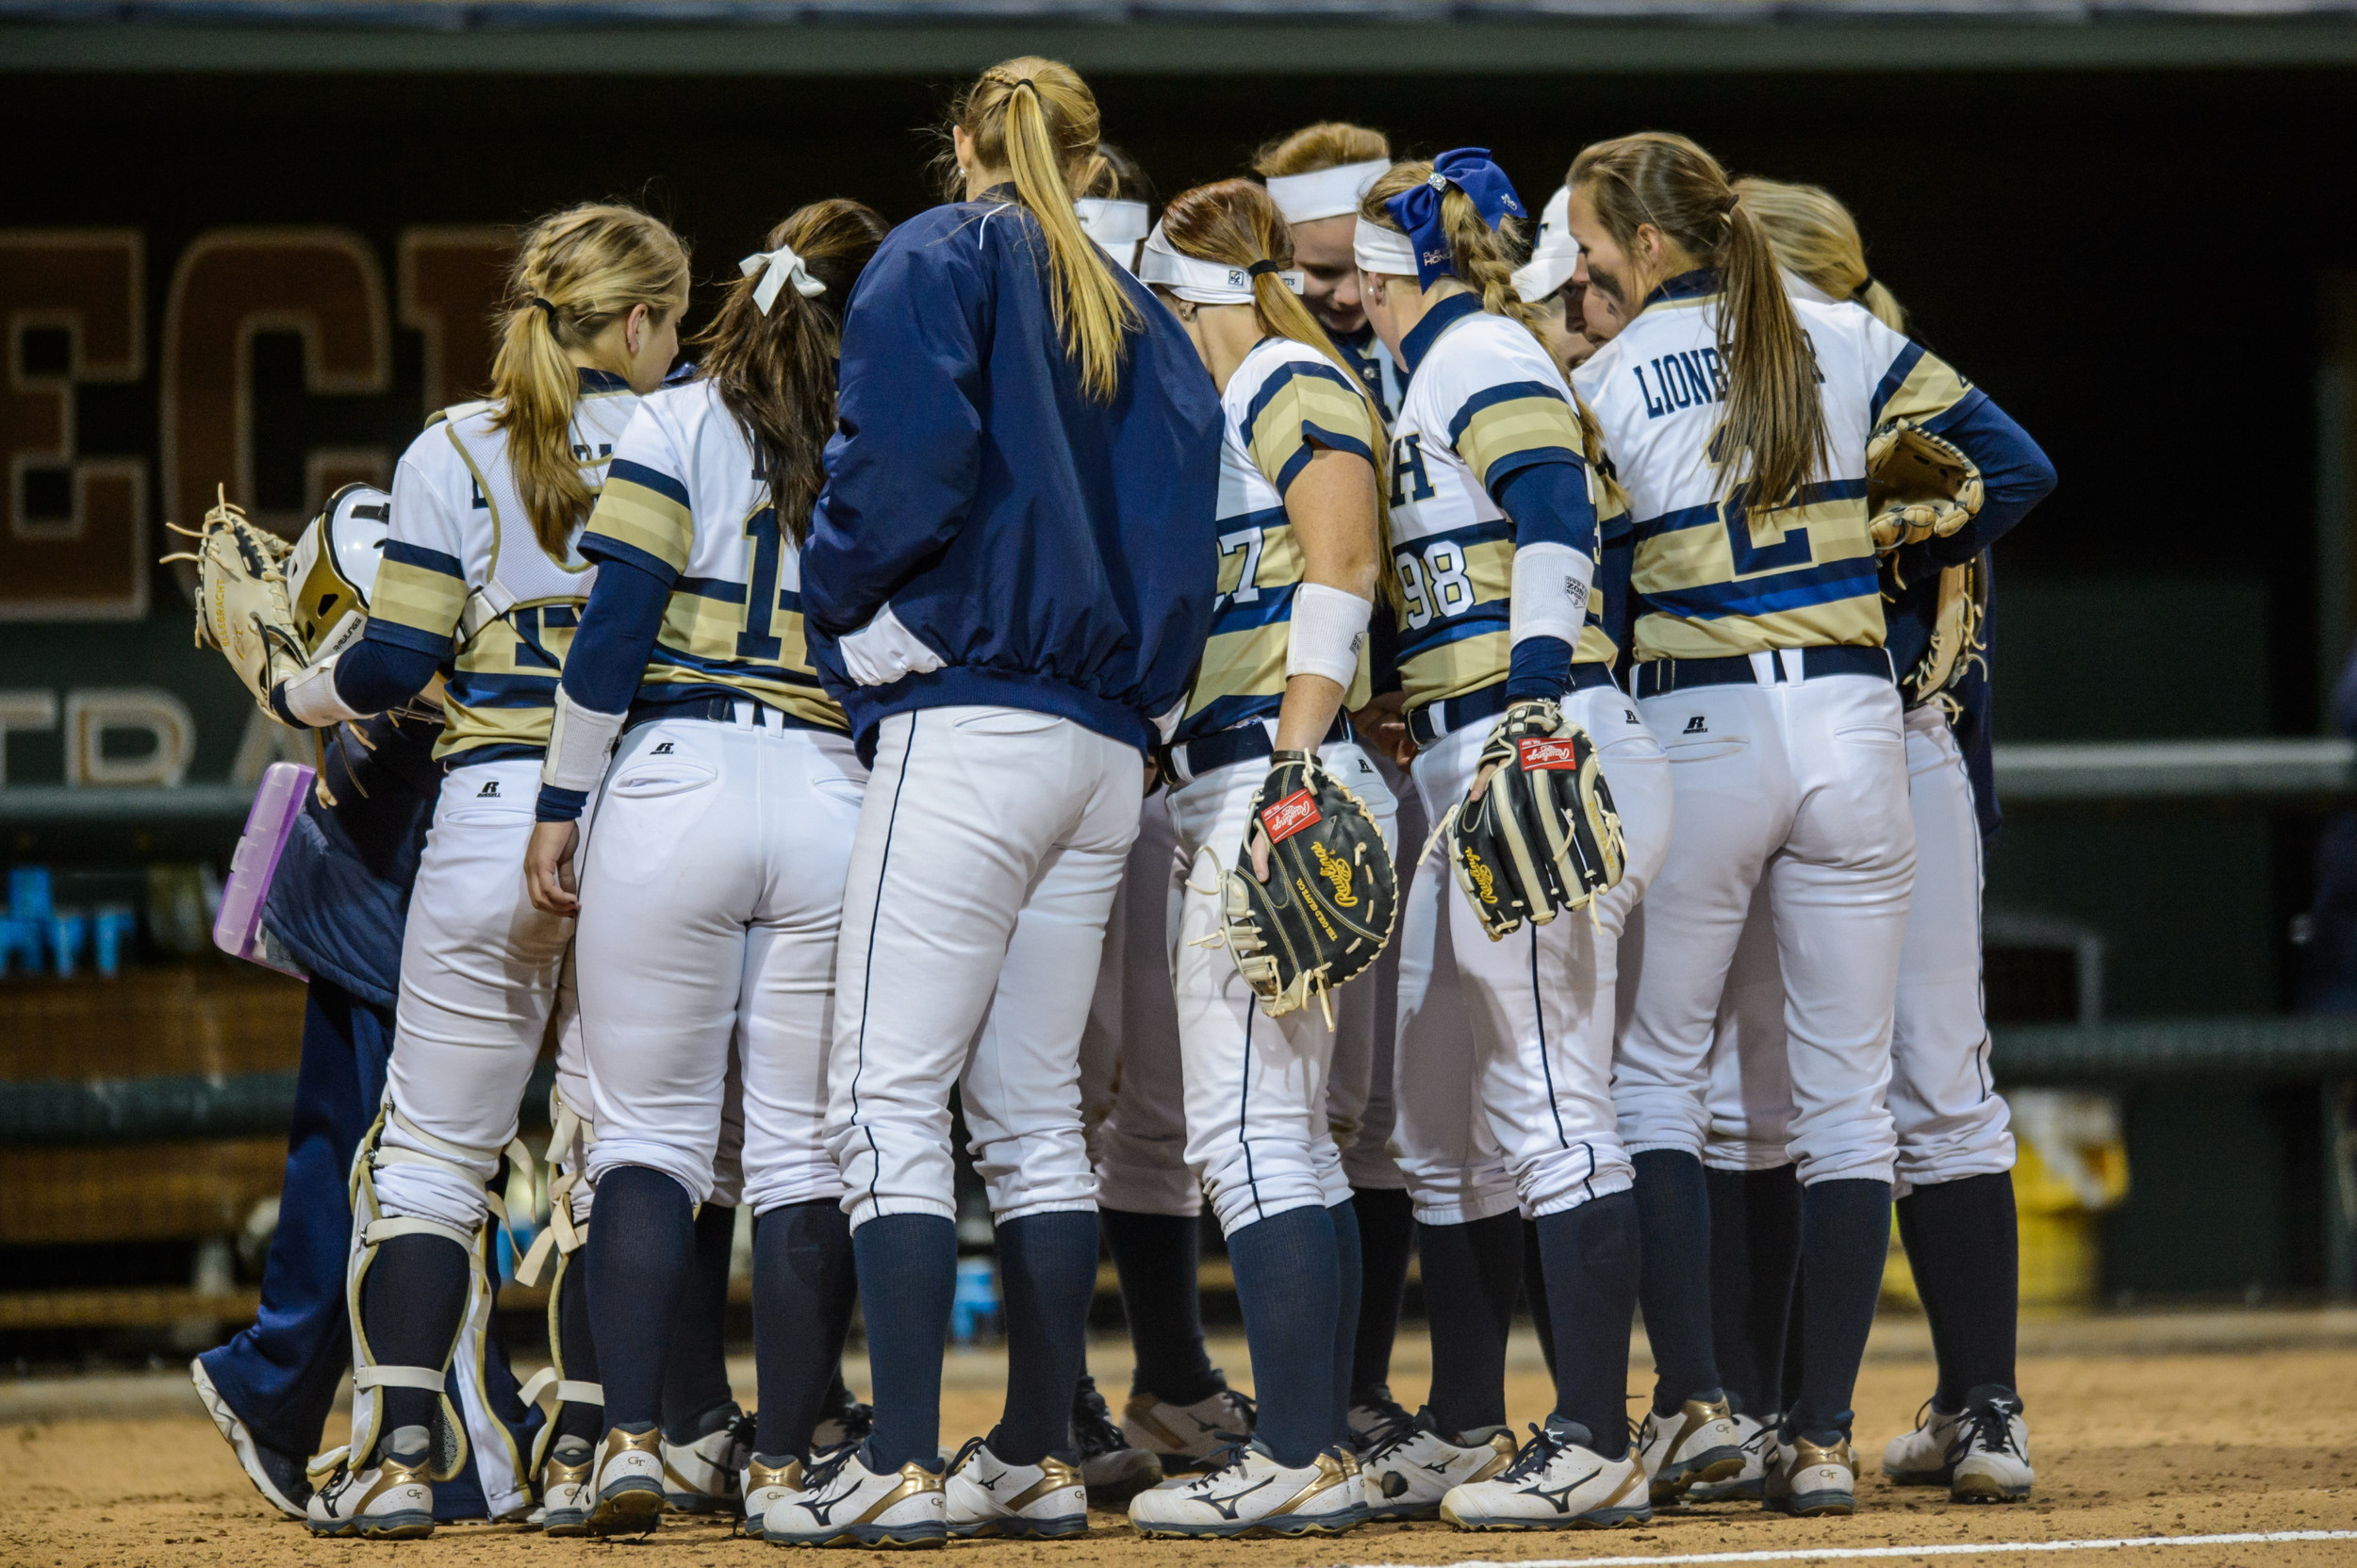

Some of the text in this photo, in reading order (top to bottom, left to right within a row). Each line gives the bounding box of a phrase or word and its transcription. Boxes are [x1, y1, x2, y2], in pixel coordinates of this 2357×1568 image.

[1393, 539, 1476, 632] 98
[215, 578, 230, 648] ELLEBRACHT
[333, 617, 363, 652] RAWLINGS
[1525, 746, 1570, 762] Rawlings
[1272, 801, 1310, 832] Rawlings
[1311, 841, 1359, 908] Rawlings
[1465, 847, 1498, 904] Rawlings
[1301, 888, 1319, 912] GLOVE
[1314, 909, 1329, 929] GOLD
[406, 1489, 422, 1500] GT
